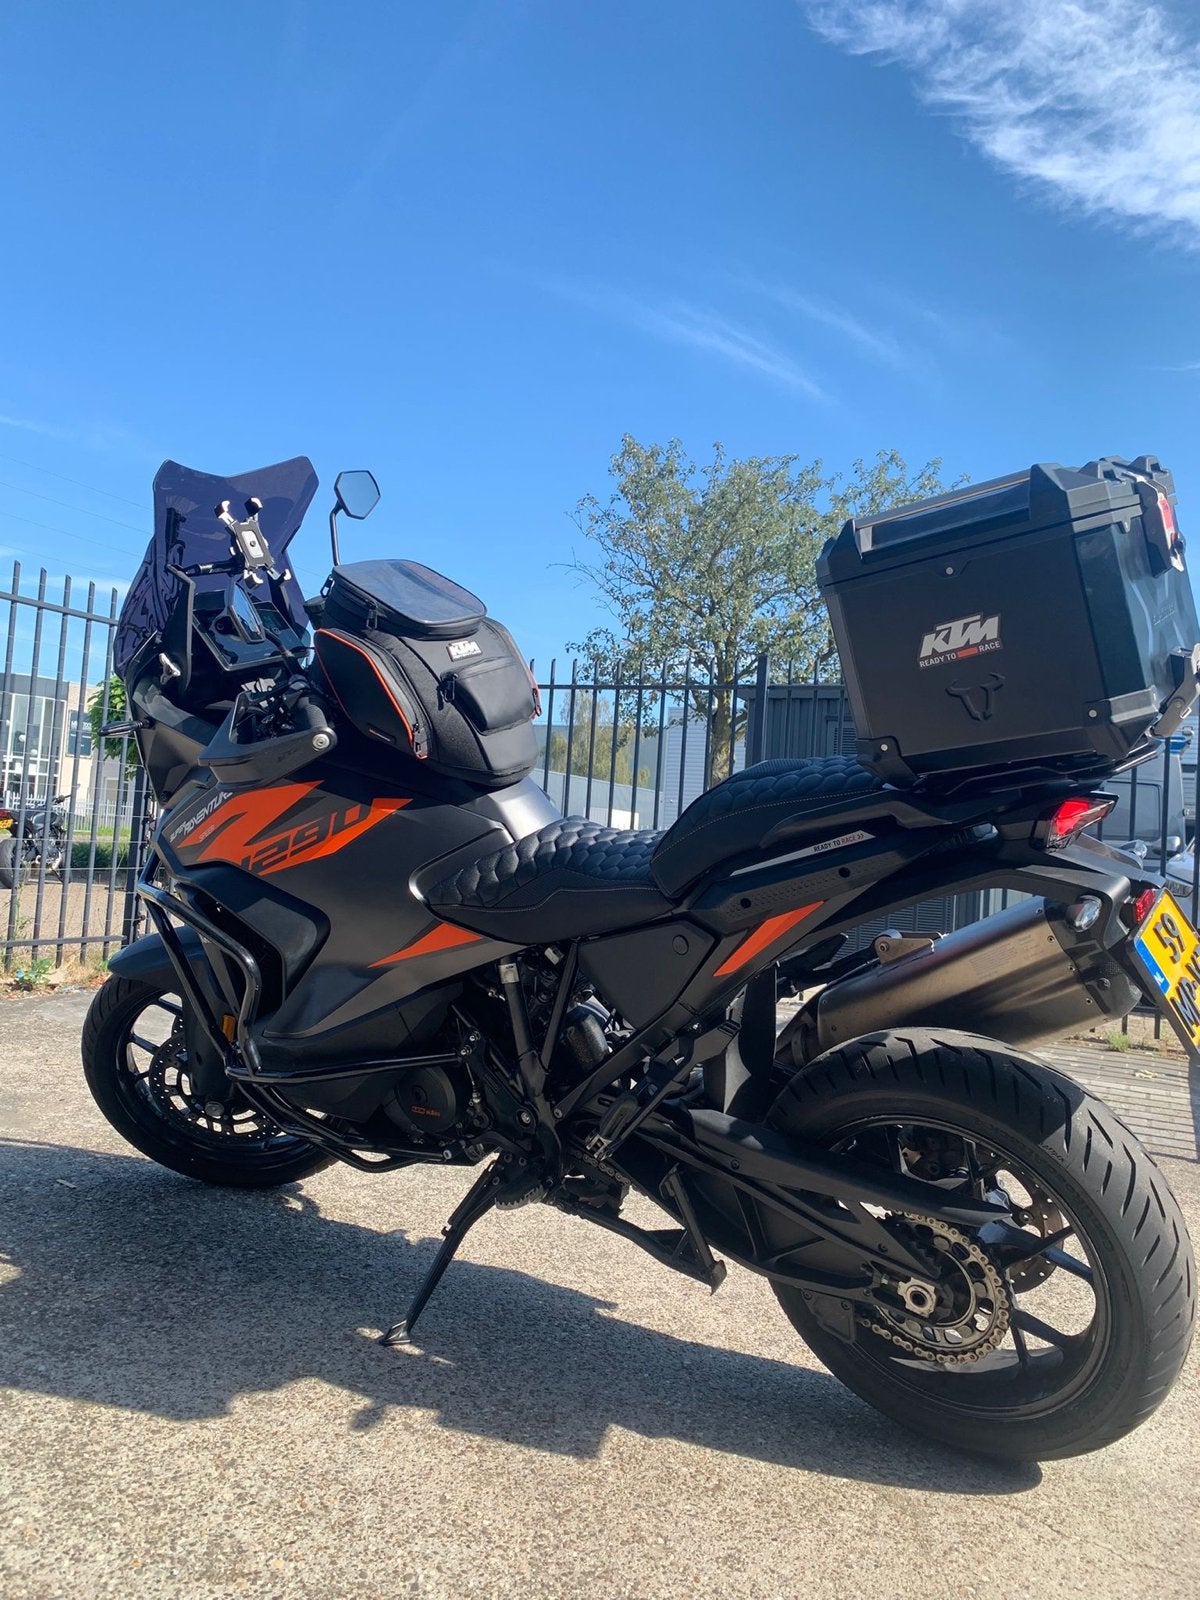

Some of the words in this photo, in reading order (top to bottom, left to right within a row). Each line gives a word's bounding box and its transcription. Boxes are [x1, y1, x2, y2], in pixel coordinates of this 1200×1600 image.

[449, 640, 480, 657] KTM
[919, 614, 999, 658] KTM
[919, 655, 945, 668] READY
[946, 652, 957, 662] TO
[978, 640, 1001, 653] RACE
[240, 799, 372, 872] 1290
[813, 842, 832, 852] READY
[832, 839, 841, 847] TO
[1153, 912, 1187, 965] 59
